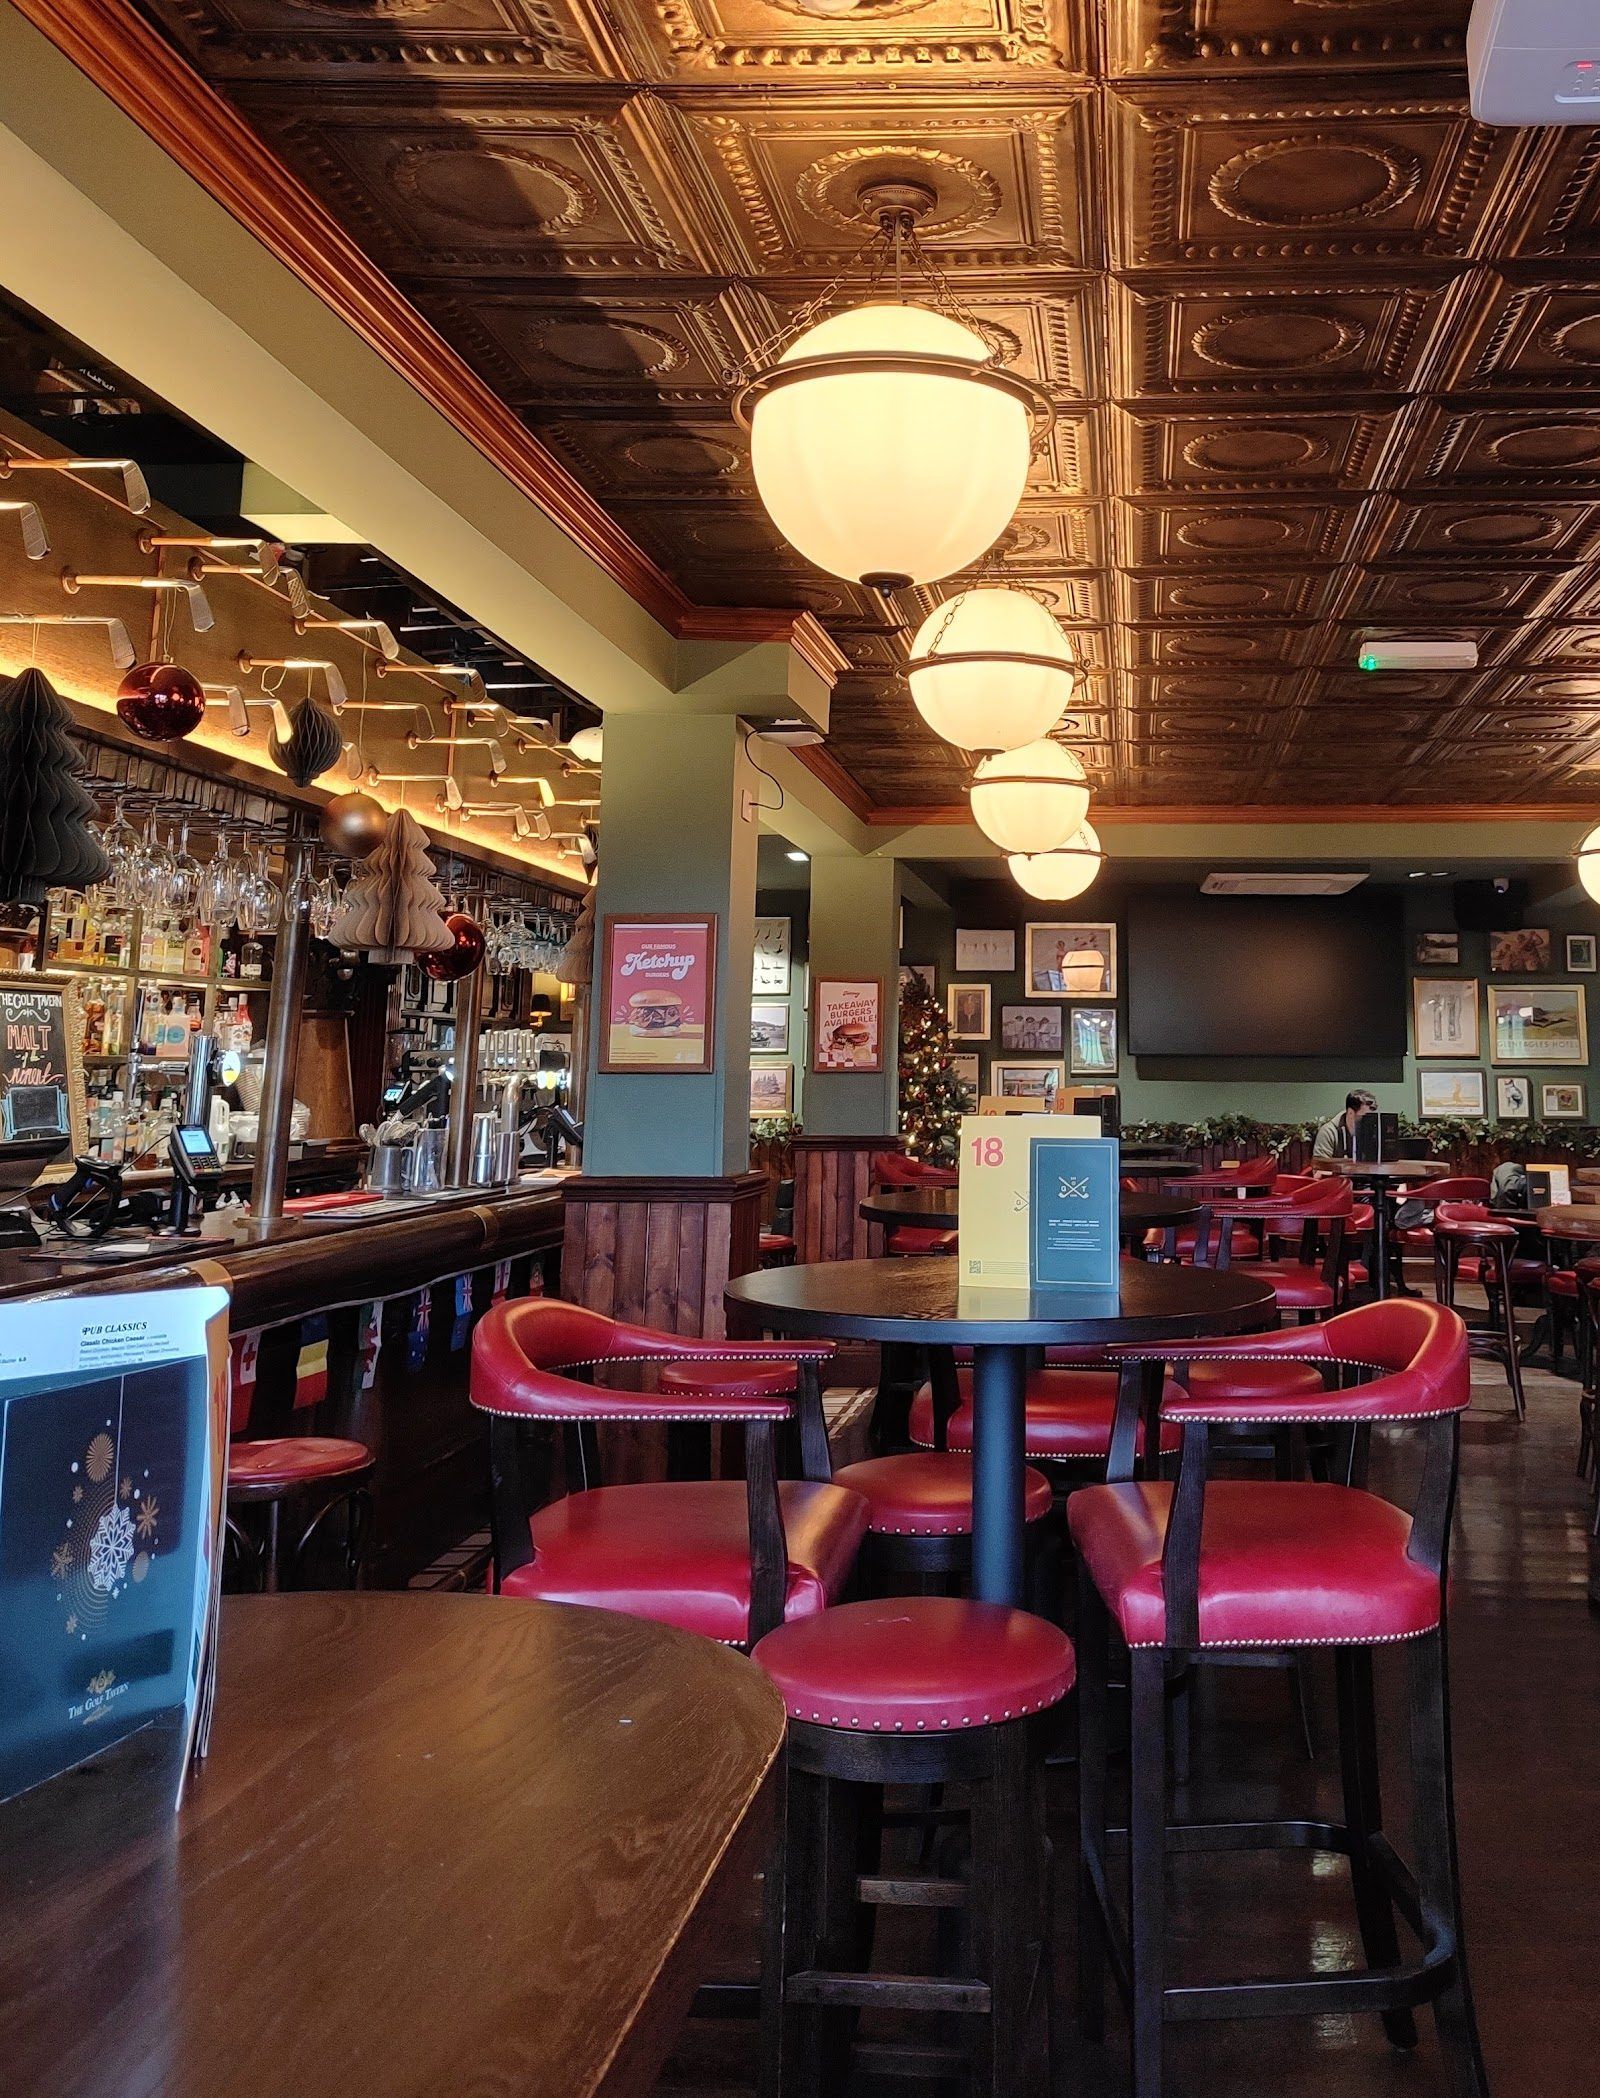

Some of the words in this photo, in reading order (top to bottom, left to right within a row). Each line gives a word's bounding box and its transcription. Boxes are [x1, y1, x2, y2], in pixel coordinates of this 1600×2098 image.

[620, 951, 696, 981] Ketchup
[13, 993, 37, 1009] GOLF
[35, 994, 62, 1010] TAVERN
[826, 999, 876, 1012] TAKEAWAY
[823, 1014, 877, 1028] AVAILABLE!
[830, 1007, 872, 1020] BURGERS
[7, 1024, 52, 1051] MALT
[971, 1137, 1004, 1167] 18
[82, 1326, 103, 1336] PUB
[104, 1321, 148, 1334] CLASSICS
[101, 1337, 125, 1345] Chicken
